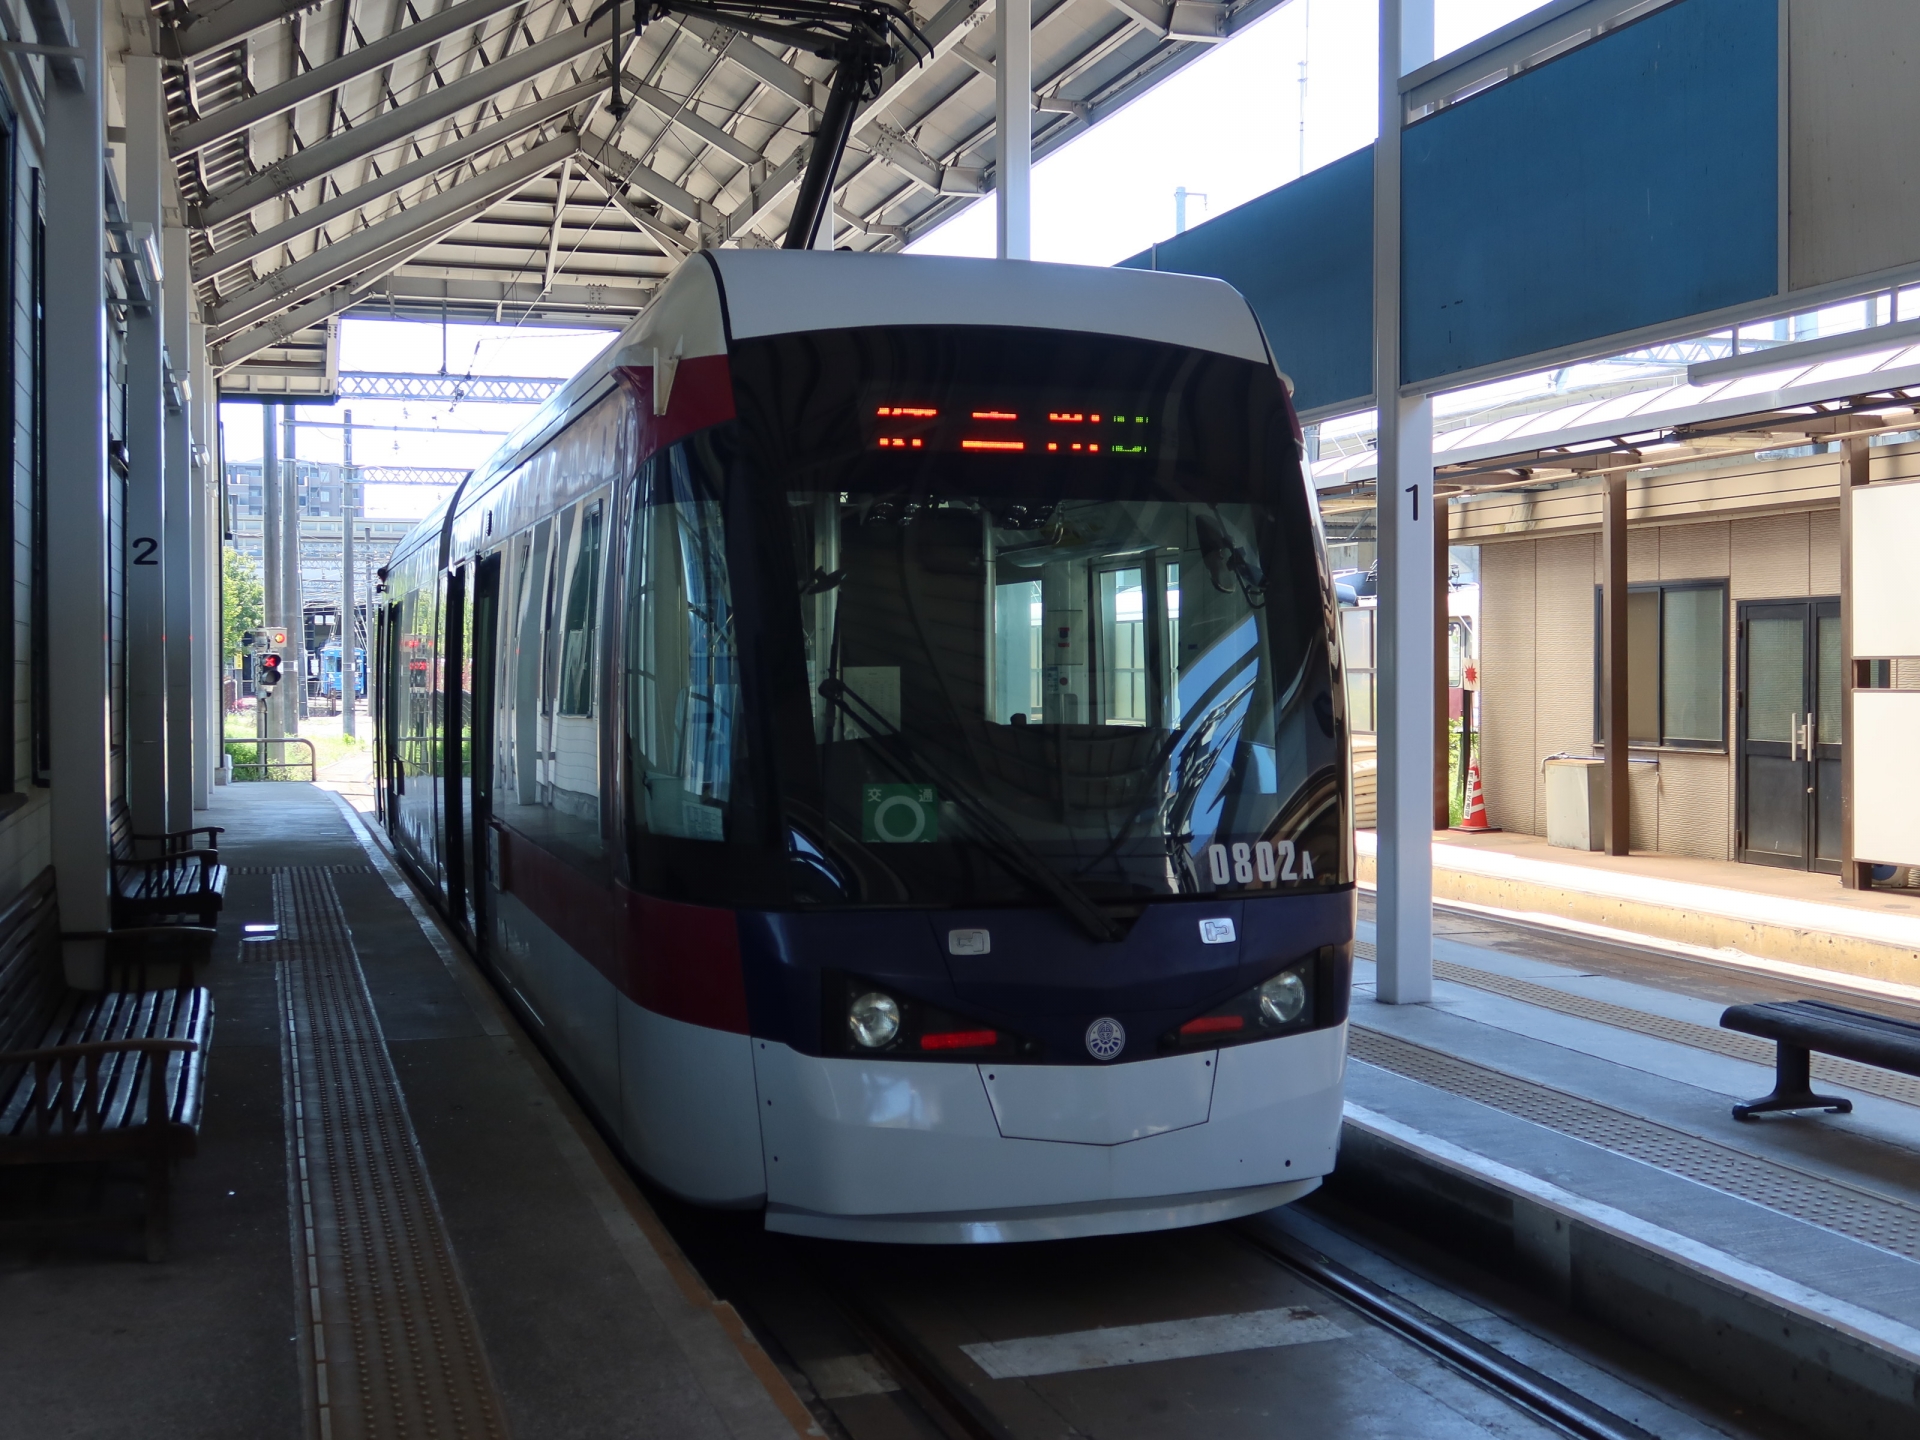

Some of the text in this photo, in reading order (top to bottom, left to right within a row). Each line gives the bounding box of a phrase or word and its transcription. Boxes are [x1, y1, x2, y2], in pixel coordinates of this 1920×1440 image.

[1405, 484, 1418, 521] 1
[132, 537, 159, 565] 2
[868, 788, 933, 803] 交 通
